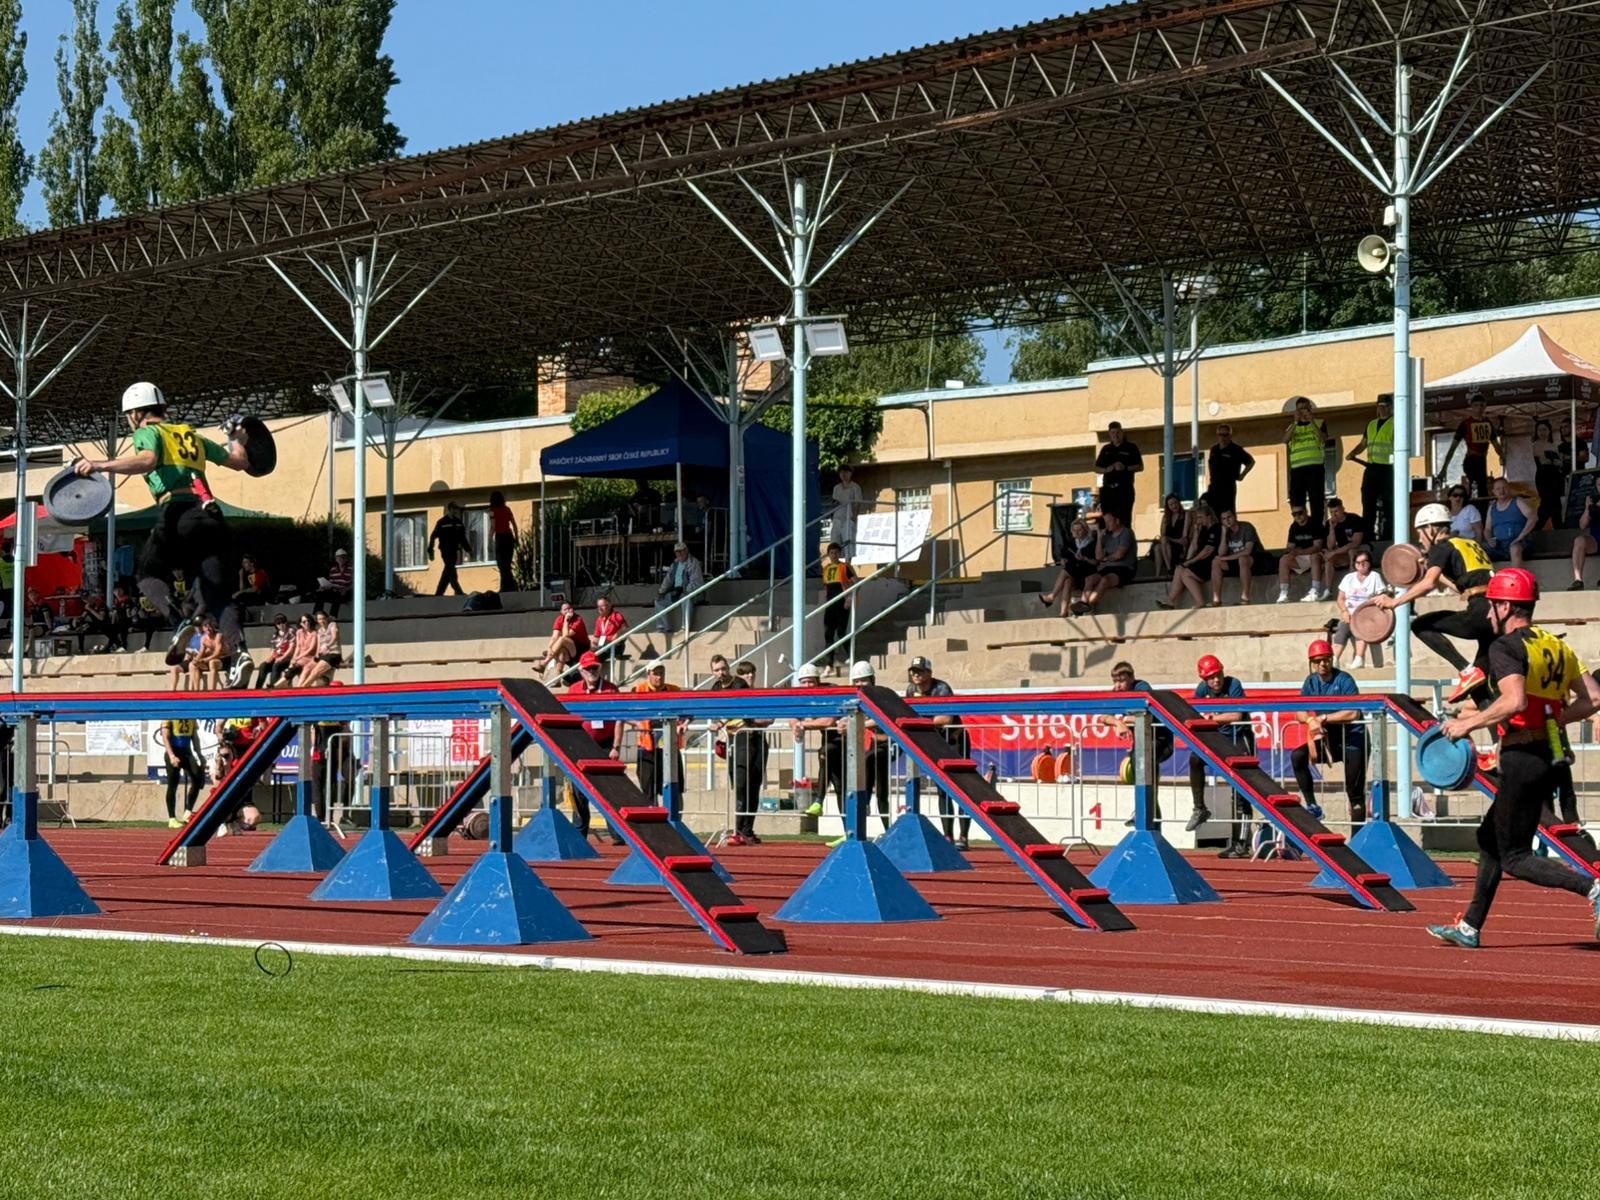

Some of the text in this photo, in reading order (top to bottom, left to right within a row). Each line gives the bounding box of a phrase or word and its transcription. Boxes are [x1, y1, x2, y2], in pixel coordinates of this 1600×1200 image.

[173, 431, 199, 461] 33
[1541, 648, 1565, 690] 34
[1089, 803, 1101, 830] 1
